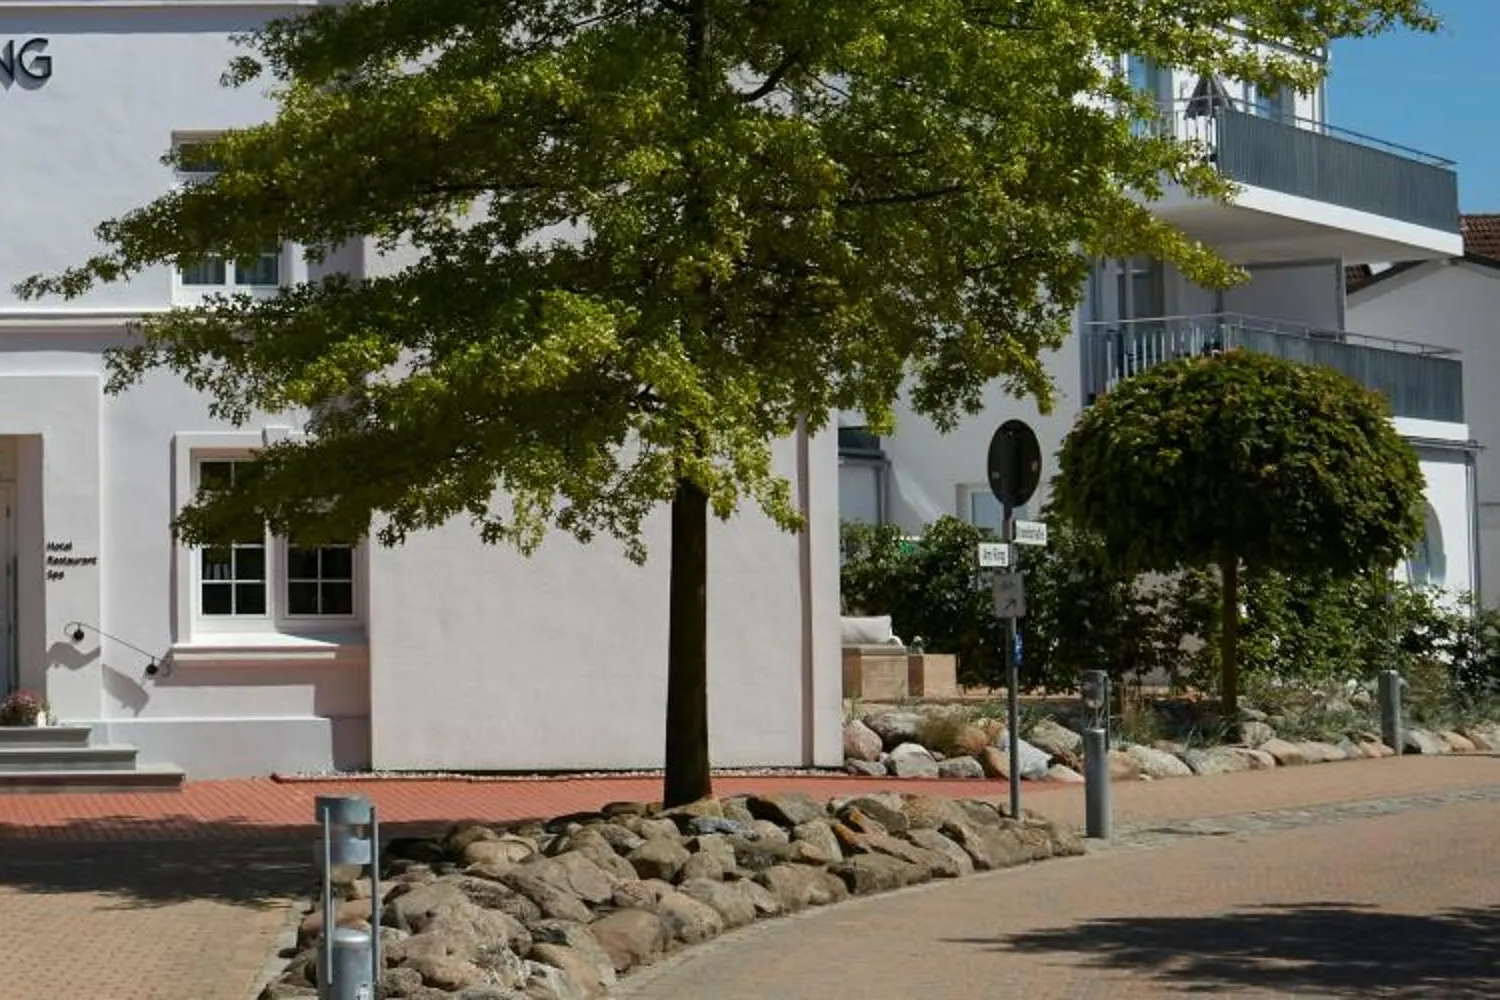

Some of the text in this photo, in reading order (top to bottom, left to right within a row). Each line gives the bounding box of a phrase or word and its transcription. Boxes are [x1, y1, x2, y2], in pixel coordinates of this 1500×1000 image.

[47, 541, 73, 550] Hotel
[47, 556, 97, 566] Restaurant
[47, 570, 65, 580] Spa
